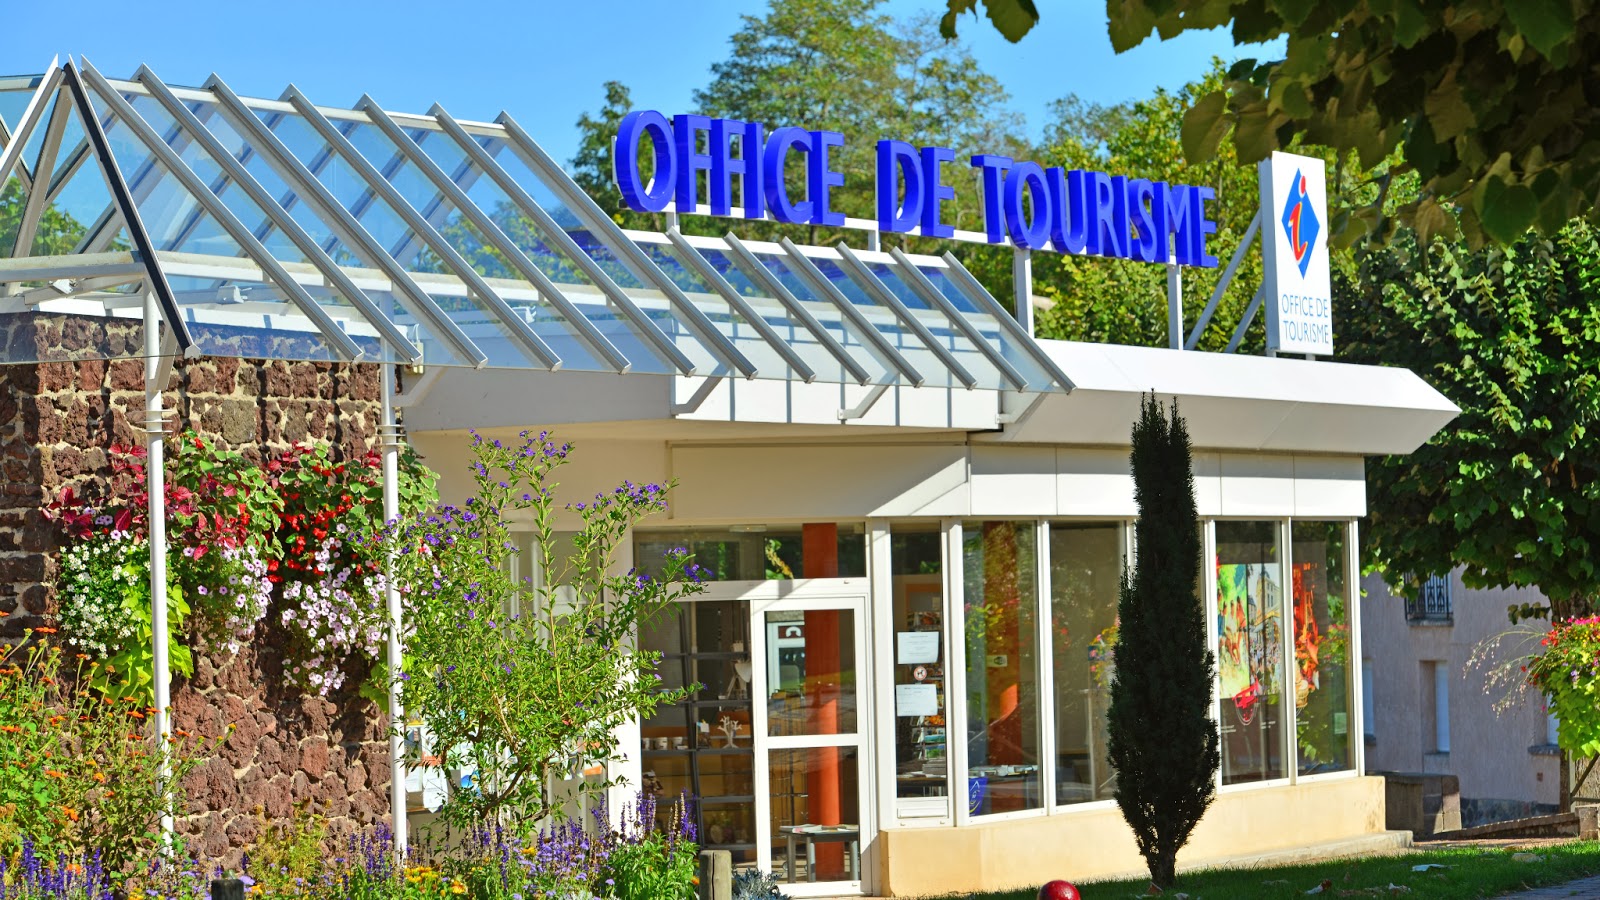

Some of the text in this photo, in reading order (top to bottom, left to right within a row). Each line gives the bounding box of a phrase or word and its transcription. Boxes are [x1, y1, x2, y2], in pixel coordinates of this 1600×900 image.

[615, 110, 1218, 268] OFFICE DE TOURISME
[1281, 294, 1328, 318] OFFICE DE
[1283, 320, 1329, 344] TOURISME
